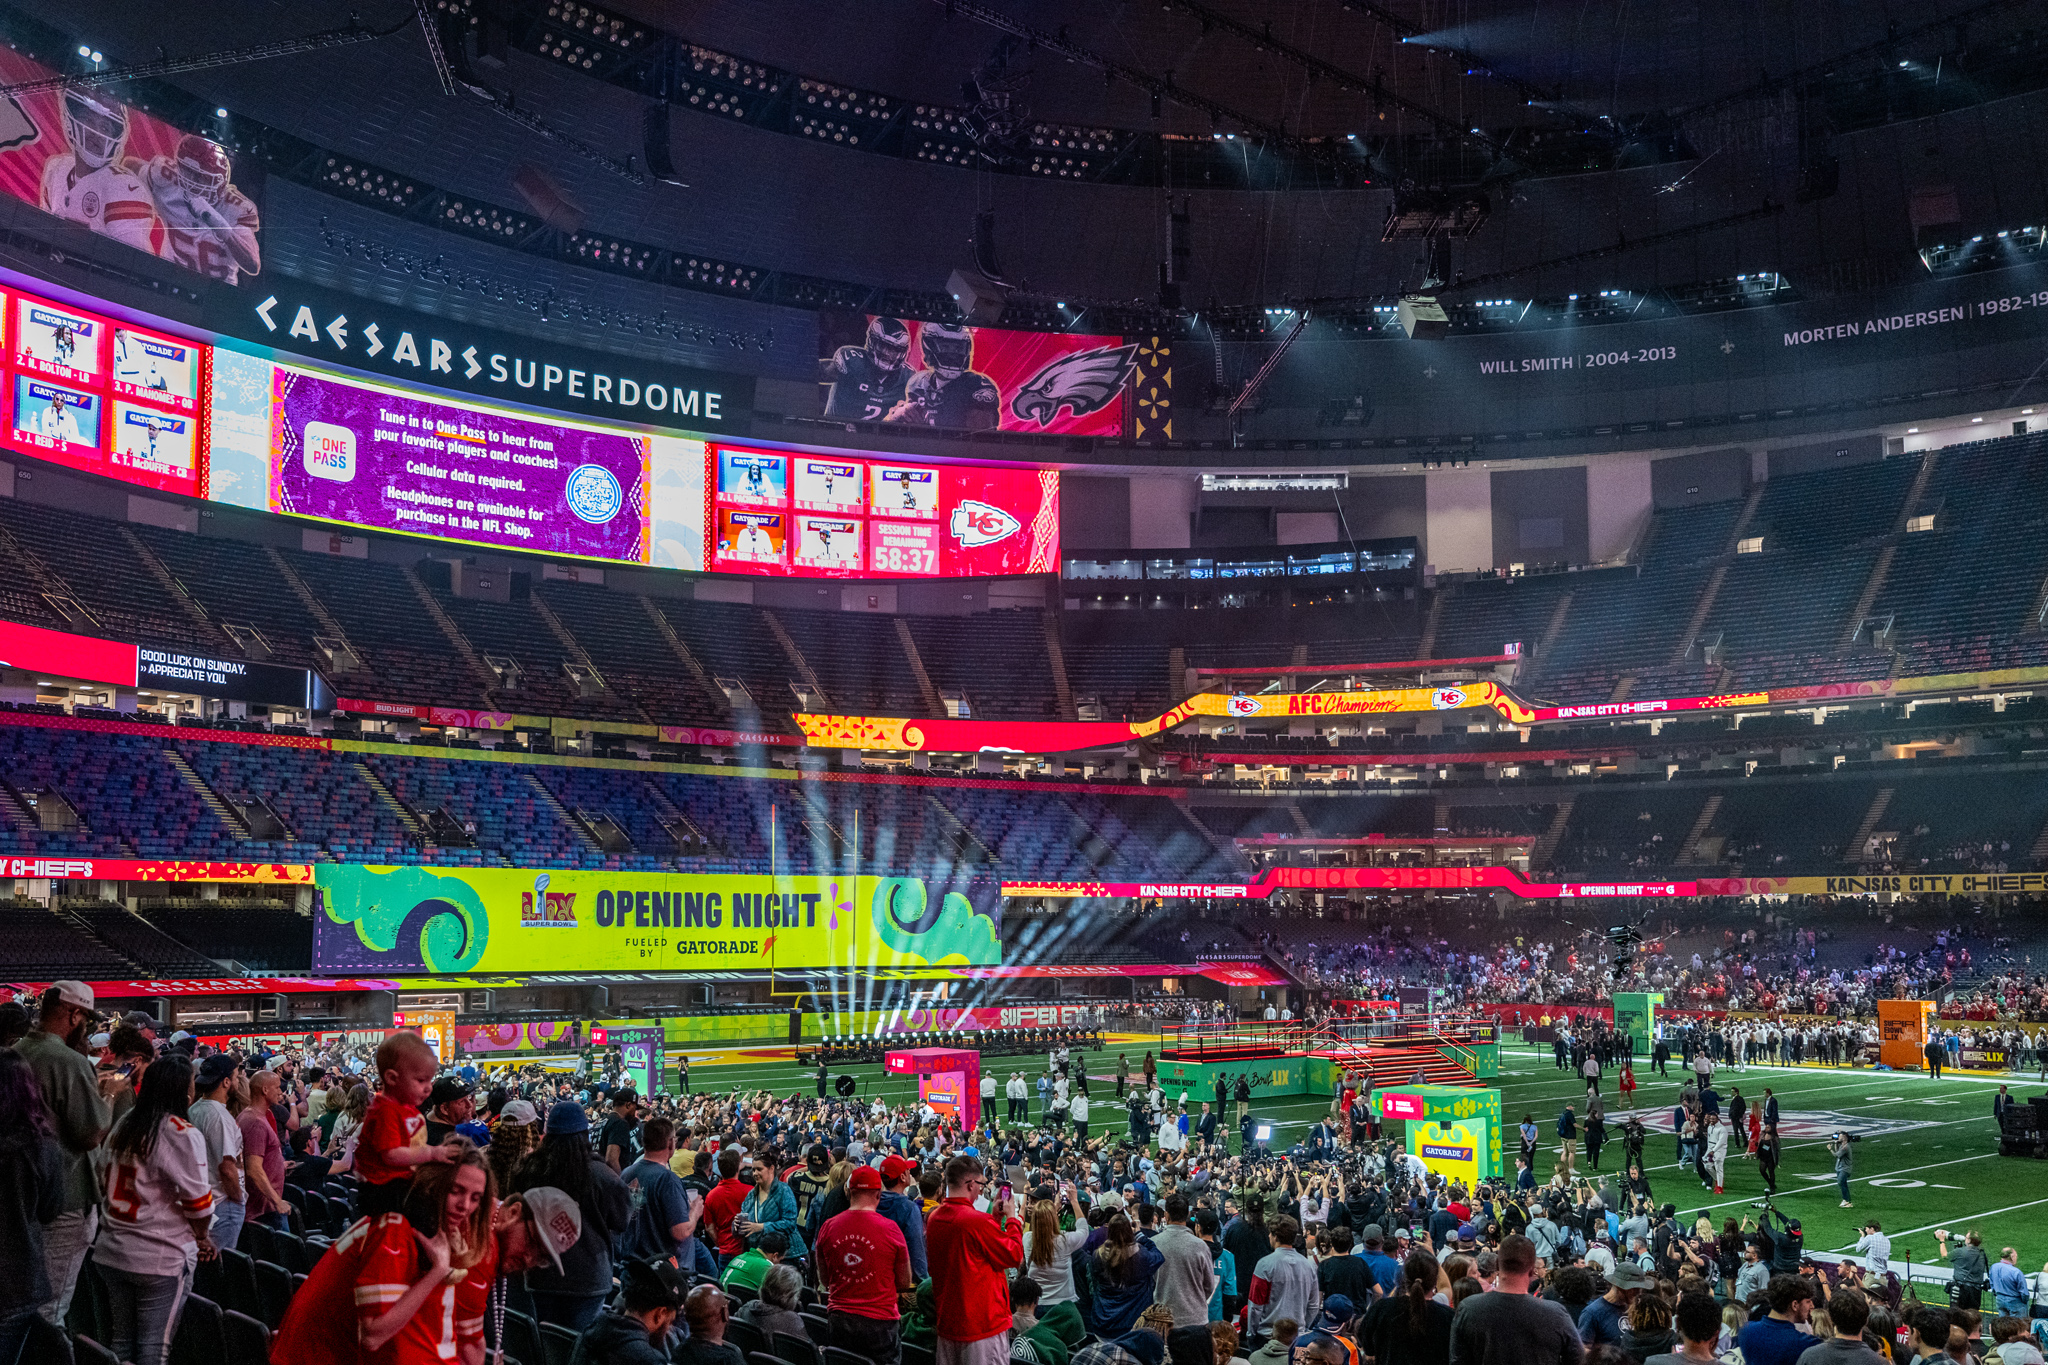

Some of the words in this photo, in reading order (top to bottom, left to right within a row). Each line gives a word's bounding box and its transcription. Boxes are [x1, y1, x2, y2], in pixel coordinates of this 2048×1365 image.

[1783, 321, 1860, 347] MORTEN
[1864, 305, 1964, 334] ANDERSEN
[255, 295, 482, 379] CAESARS
[490, 354, 722, 420] SUPERDOME
[1480, 360, 1518, 375] WILL
[1522, 356, 1573, 373] SMITH
[16, 354, 26, 366] 2.
[28, 357, 38, 370] N.
[39, 361, 72, 379] BOLTON
[79, 371, 90, 384] LB
[114, 380, 123, 393] 3.
[125, 383, 134, 396] P.
[135, 385, 175, 406] MAHOMES
[380, 408, 406, 425] Tune
[408, 414, 419, 428] in
[422, 418, 434, 431] to
[437, 419, 458, 435] One
[460, 424, 486, 440] Pass
[488, 429, 500, 442] to
[502, 432, 527, 447] hear
[529, 436, 554, 451] from
[13, 429, 22, 441] 5.
[25, 432, 33, 444] J.
[35, 435, 55, 449] REID
[61, 442, 67, 452] S
[321, 436, 347, 455] ONE
[374, 428, 400, 442] your
[402, 431, 445, 451] favorite
[447, 441, 487, 458] players
[489, 448, 510, 462] and
[512, 453, 559, 470] coaches!
[313, 451, 347, 470] PASS
[1836, 449, 1848, 457] 611
[111, 453, 120, 465] 6.
[122, 456, 131, 467] T.
[133, 458, 171, 475] McDUFFIE
[18, 470, 32, 480] 650
[406, 460, 448, 479] Cellular
[450, 468, 475, 484] data
[478, 475, 526, 492] required.
[387, 485, 454, 508] Headphones
[456, 497, 475, 511] are
[477, 499, 526, 519] available
[528, 506, 544, 521] for
[202, 510, 214, 519] 651
[396, 508, 446, 525] purchase
[448, 513, 458, 526] in
[461, 515, 480, 529] the
[482, 518, 501, 533] NFL
[504, 521, 534, 539] Shop.
[878, 523, 912, 536] SESSION
[912, 526, 932, 538] TIME
[883, 536, 927, 549] REMAINING
[875, 546, 935, 572] 58:37
[480, 580, 491, 588] 601
[141, 649, 167, 663] GOOD
[167, 653, 192, 667] LUCK
[193, 657, 206, 669] ON
[207, 659, 247, 675] SUNDAY.
[147, 663, 205, 682] APPRECIATE
[206, 671, 227, 684] YOU.
[376, 704, 392, 712] BUD
[392, 706, 414, 714] LIGHT
[1287, 694, 1322, 715] AFC
[1323, 693, 1404, 714] Champions
[1558, 705, 1596, 718] KANSAS
[1597, 704, 1620, 715] CITY
[1621, 701, 1668, 713] CHIEFS
[739, 733, 781, 743] CAESARS
[12, 859, 93, 878] CHIEFS
[1140, 885, 1179, 897] KANSAS
[1180, 885, 1202, 897] CITY
[1203, 886, 1247, 897] CHIEFS
[1580, 886, 1616, 896] OPENING
[1617, 885, 1644, 895] NIGHT
[1826, 876, 1901, 893] KANSAS
[1909, 876, 1952, 891] CITY
[595, 889, 723, 928] OPENING
[733, 893, 822, 928] NIGHT
[625, 938, 668, 946] FUELED
[676, 939, 759, 955] GATORADE
[640, 949, 654, 957] BY
[128, 978, 262, 989] CAESARS
[145, 985, 269, 994] SUPERDOME
[1000, 1008, 1058, 1026] SUPER
[1884, 1019, 1916, 1028] SUPER
[1480, 1028, 1492, 1037] LIX
[1884, 1033, 1899, 1041] LIX
[1986, 1052, 2004, 1063] LIX
[1161, 1077, 1181, 1086] OPENING
[1182, 1079, 1197, 1087] NIGHT
[1249, 1071, 1274, 1088] Bowl
[1272, 1070, 1289, 1086] LIX
[1425, 1147, 1461, 1157] GATORADE
[799, 1180, 817, 1194] WHO
[845, 1234, 876, 1250] JOSEPH
